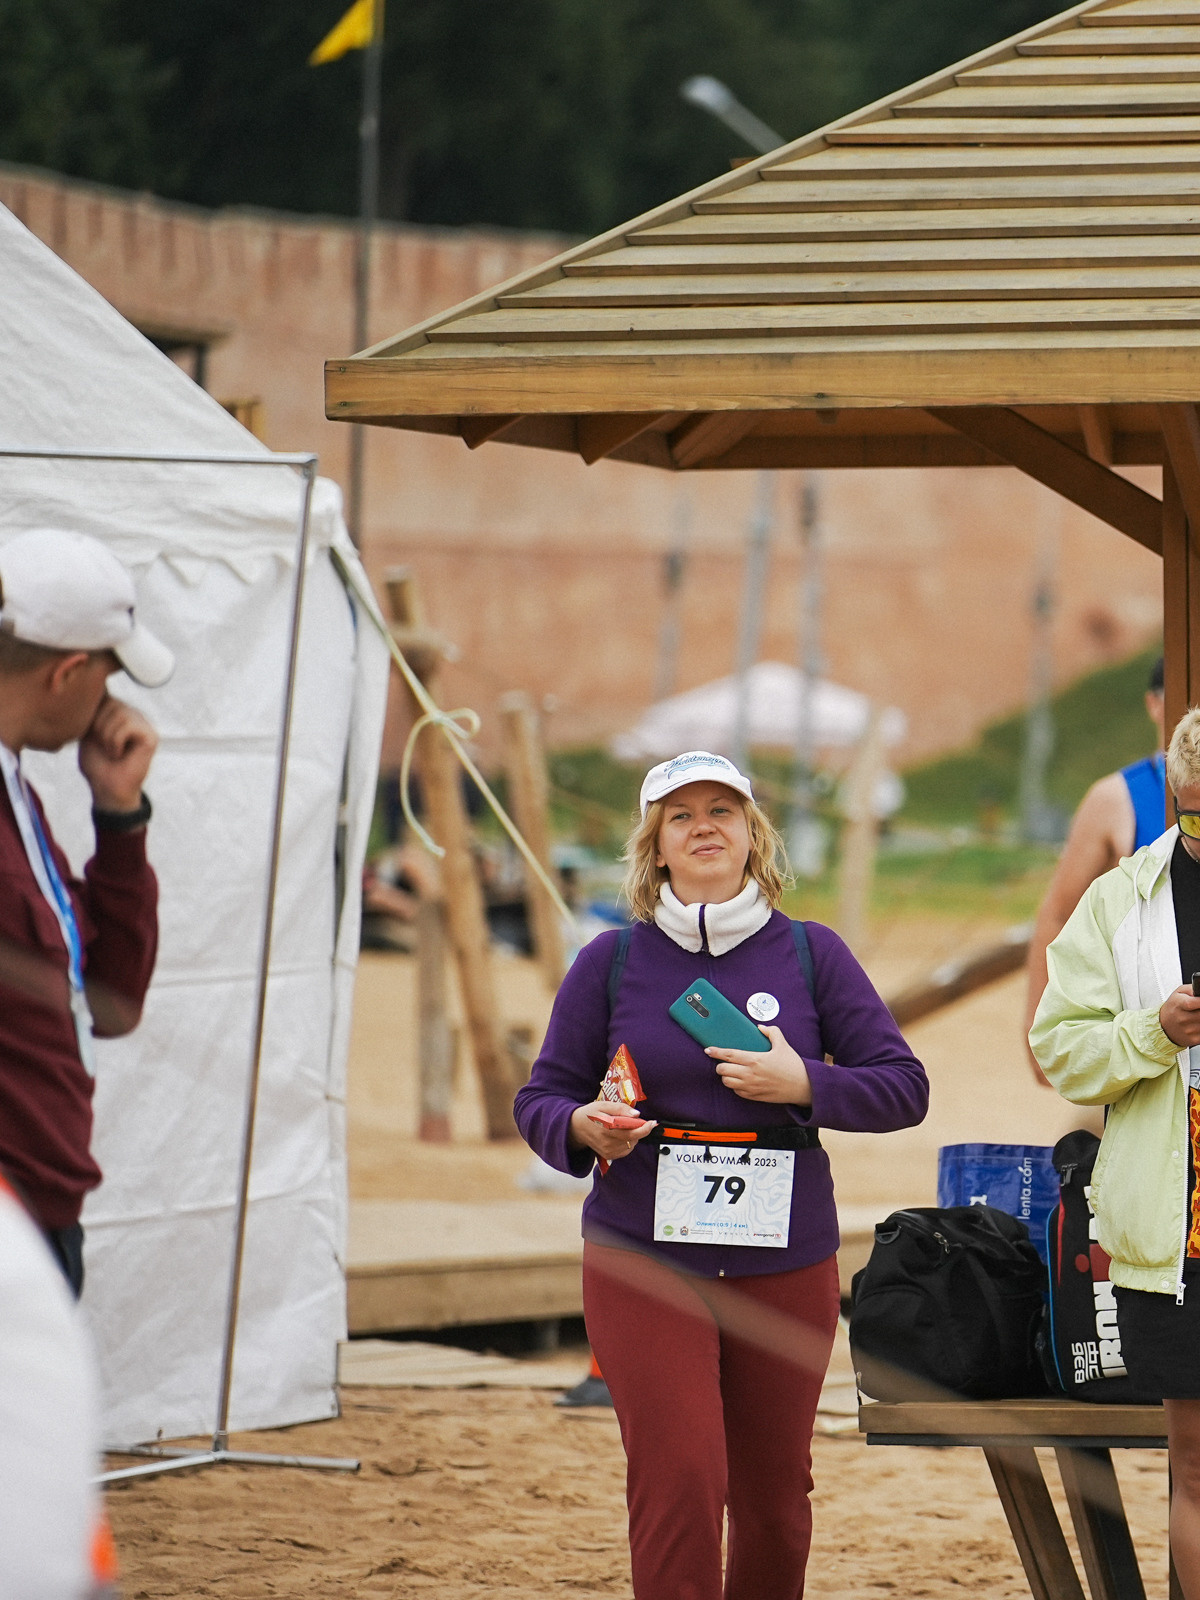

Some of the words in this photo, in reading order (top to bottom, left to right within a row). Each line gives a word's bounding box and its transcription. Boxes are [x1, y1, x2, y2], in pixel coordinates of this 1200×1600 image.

[754, 1157, 777, 1167] 2023
[703, 1175, 746, 1205] 79
[1071, 1342, 1086, 1384] ВЭБ
